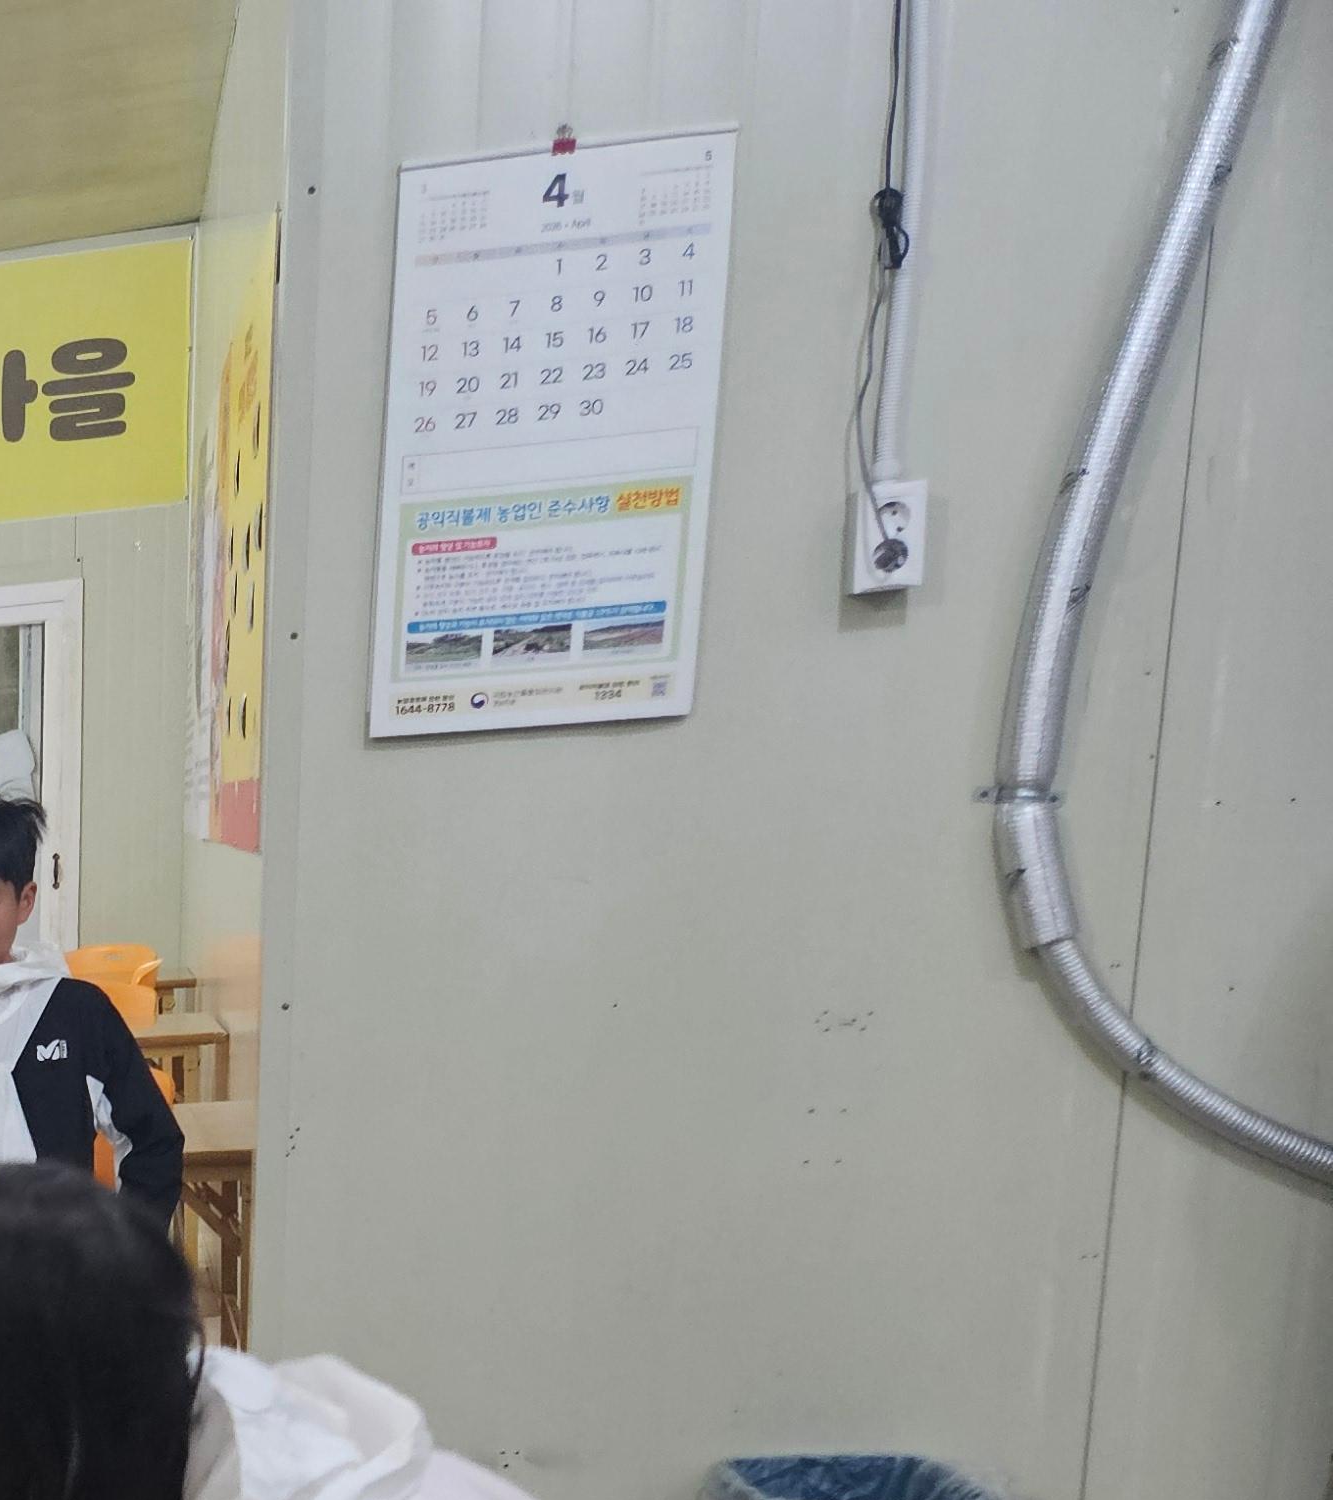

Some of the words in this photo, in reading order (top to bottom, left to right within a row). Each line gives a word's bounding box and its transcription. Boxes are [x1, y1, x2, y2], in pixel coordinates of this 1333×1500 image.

[543, 173, 570, 208] 4
[571, 218, 592, 231] April
[557, 259, 562, 275] 1
[596, 254, 607, 271] 2
[639, 250, 651, 265] 3
[683, 244, 695, 260] 4
[427, 310, 437, 325] 5
[466, 306, 478, 321] 6
[509, 300, 520, 317] 7
[551, 296, 563, 312] 8
[593, 291, 605, 307] 9
[634, 286, 653, 301] 10
[680, 280, 693, 297] 11
[422, 345, 438, 362] 12
[463, 342, 480, 357] 13
[504, 337, 522, 353] 14
[546, 332, 564, 348] 15
[588, 327, 607, 343] 16
[633, 322, 650, 339] 17
[675, 317, 693, 333] 18
[420, 381, 437, 397] 19
[457, 378, 480, 394] 20
[500, 373, 519, 389] 21
[541, 368, 563, 385] 22
[583, 364, 606, 380] 23
[625, 359, 648, 375] 24
[669, 353, 693, 370] 25
[415, 417, 436, 433] 26
[454, 413, 477, 430] 27
[496, 408, 519, 425] 28
[538, 404, 561, 421] 29
[580, 400, 603, 415] 30
[416, 506, 491, 531] 공익직불제
[496, 501, 543, 524] 농업인
[547, 494, 611, 518] 준수사항
[616, 487, 681, 512] 실천방법
[395, 701, 455, 716] 1644-8778
